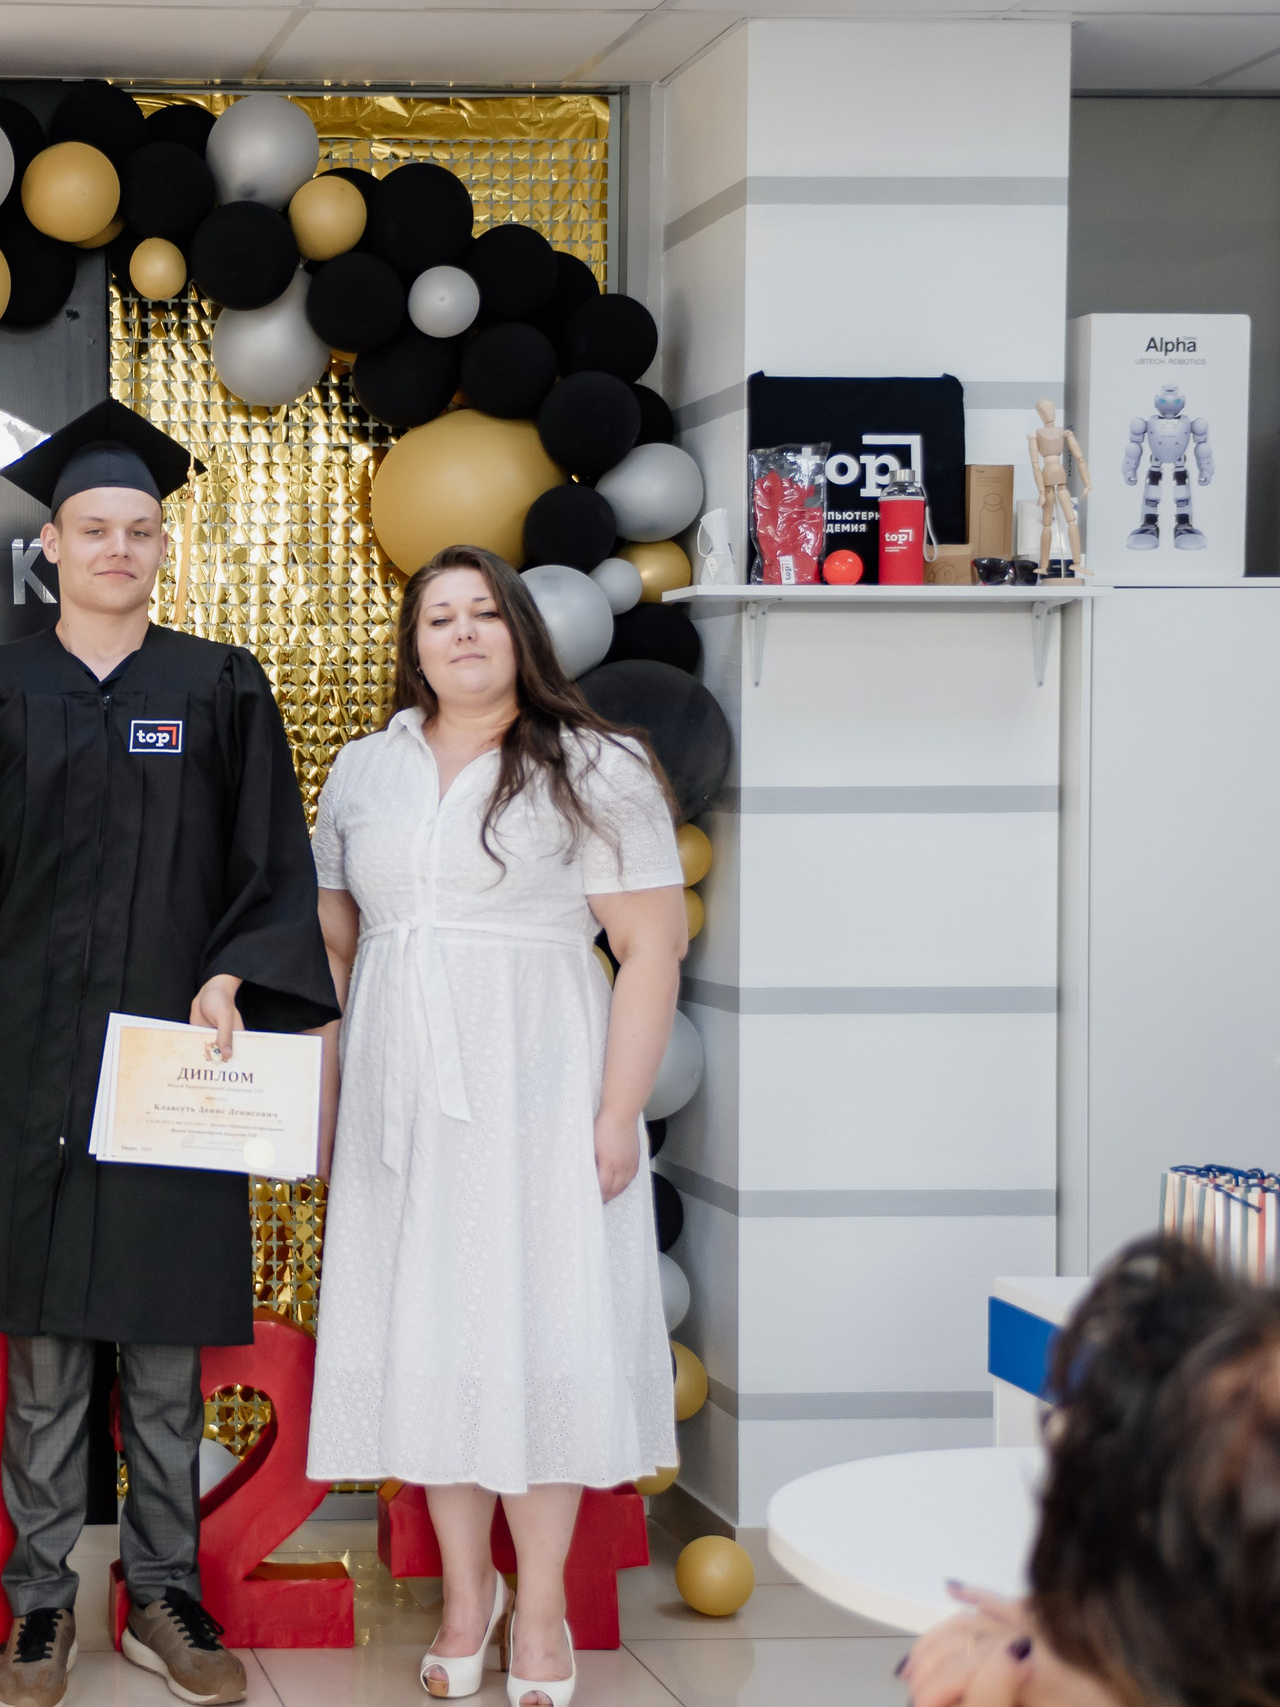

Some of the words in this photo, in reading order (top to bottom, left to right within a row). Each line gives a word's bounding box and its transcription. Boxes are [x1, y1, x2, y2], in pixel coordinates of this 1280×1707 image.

[1145, 336, 1196, 356] Alpha
[823, 523, 866, 533] ДЕМИЯ
[884, 532, 908, 544] top
[136, 729, 170, 747] top
[177, 1067, 254, 1084] ДИПЛОМ
[198, 1106, 225, 1115] Денис
